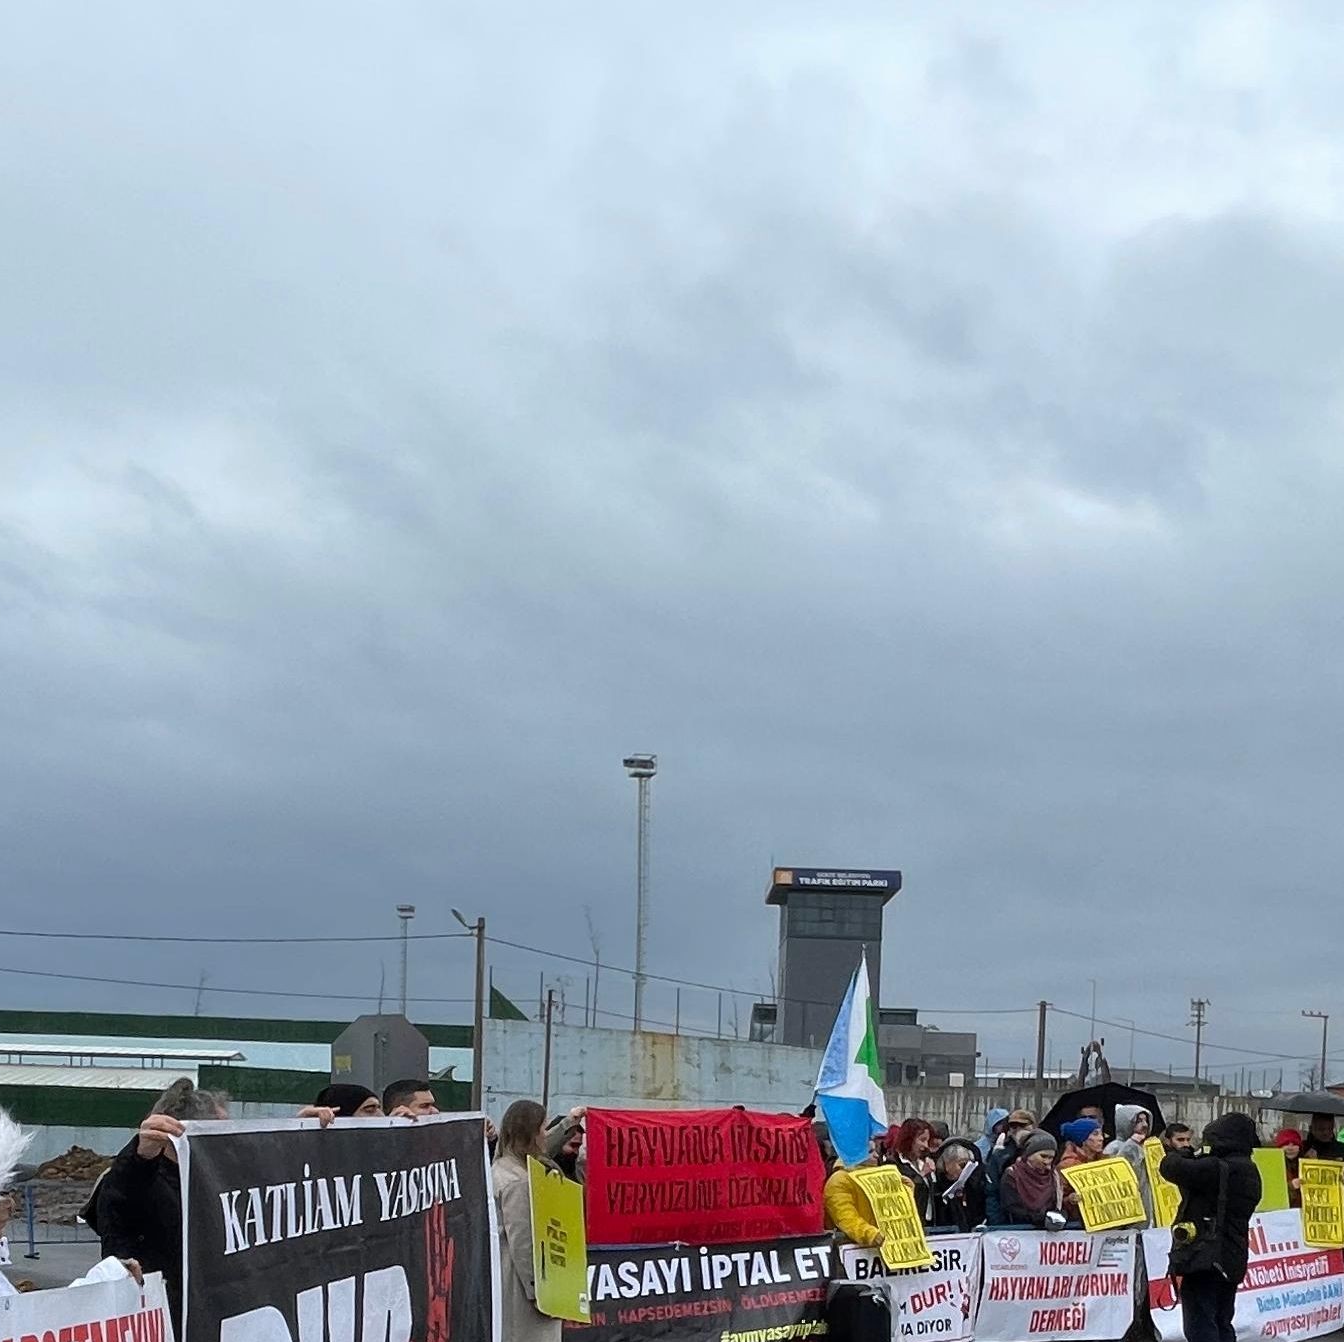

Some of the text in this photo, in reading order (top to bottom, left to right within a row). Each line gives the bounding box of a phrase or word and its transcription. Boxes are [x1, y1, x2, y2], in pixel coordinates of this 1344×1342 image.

[219, 1158, 462, 1255] KATLİAM YASASINA
[700, 1247, 791, 1291] İPTAL
[794, 1245, 832, 1281] ET
[911, 1281, 954, 1315] DUR!
[988, 1275, 1073, 1301] HAYVANLARI
[1074, 1273, 1128, 1298] KORUMA
[1029, 1302, 1086, 1333] DERNEĞİ
